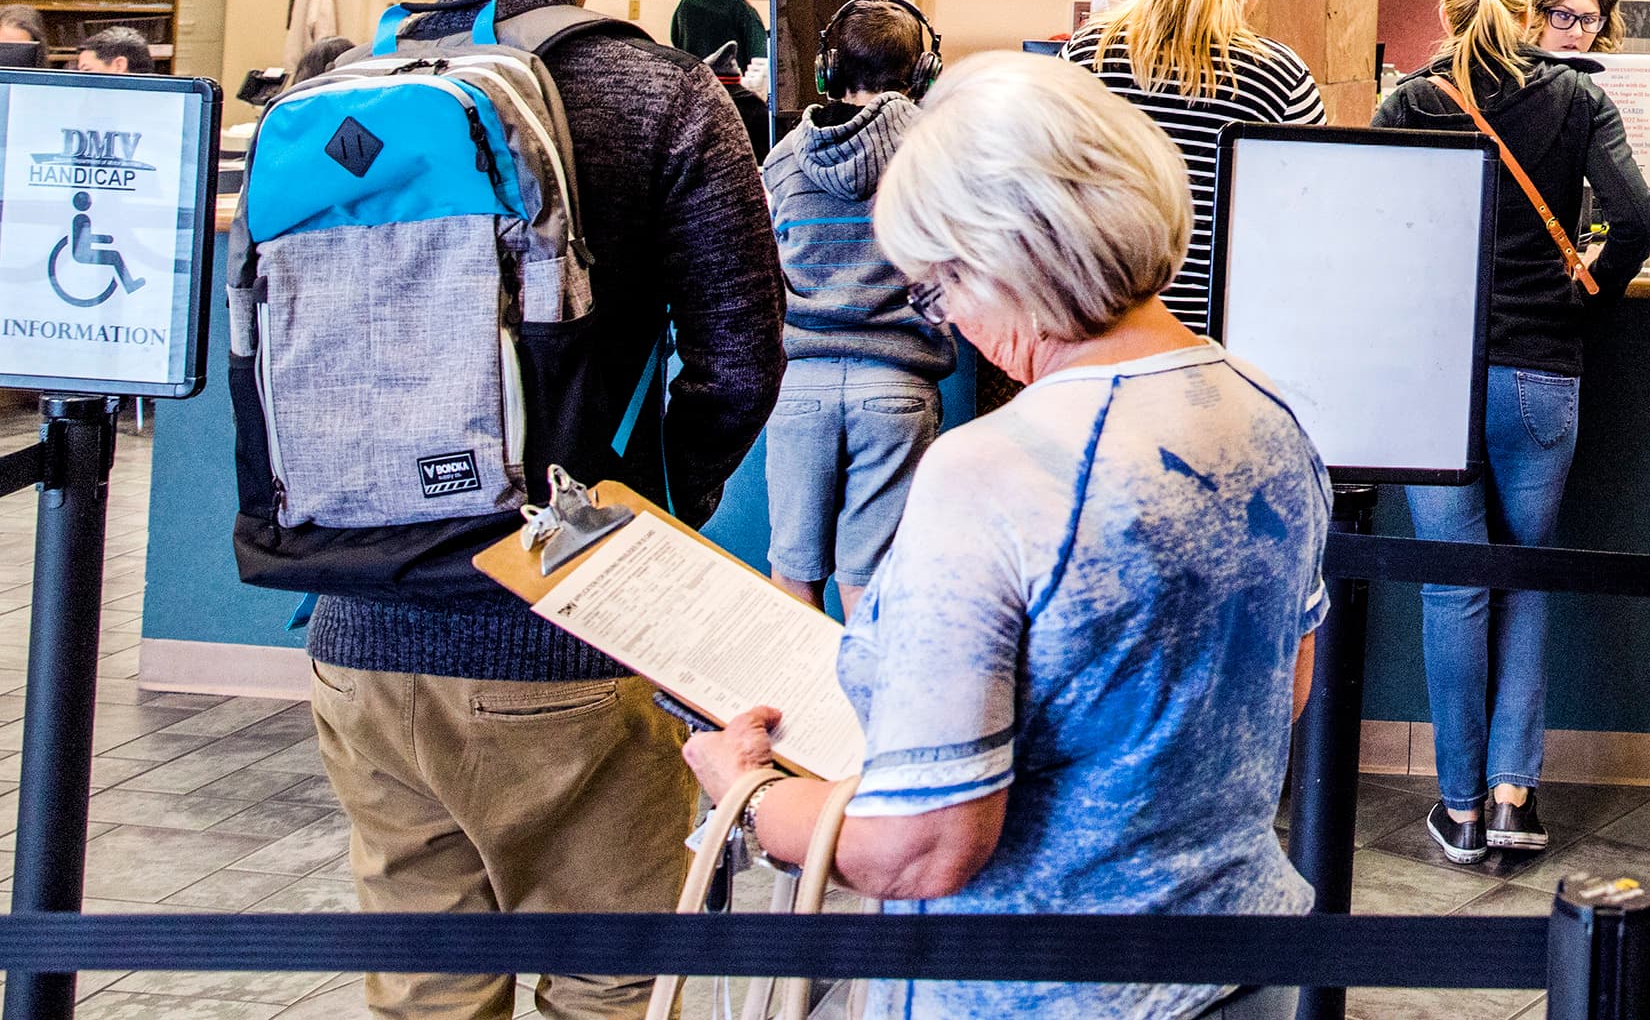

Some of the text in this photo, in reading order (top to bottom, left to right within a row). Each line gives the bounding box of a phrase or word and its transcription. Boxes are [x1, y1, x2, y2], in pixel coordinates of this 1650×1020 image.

[61, 128, 142, 160] DMV
[30, 165, 136, 186] HANDICAP
[3, 318, 166, 345] INFORMATION
